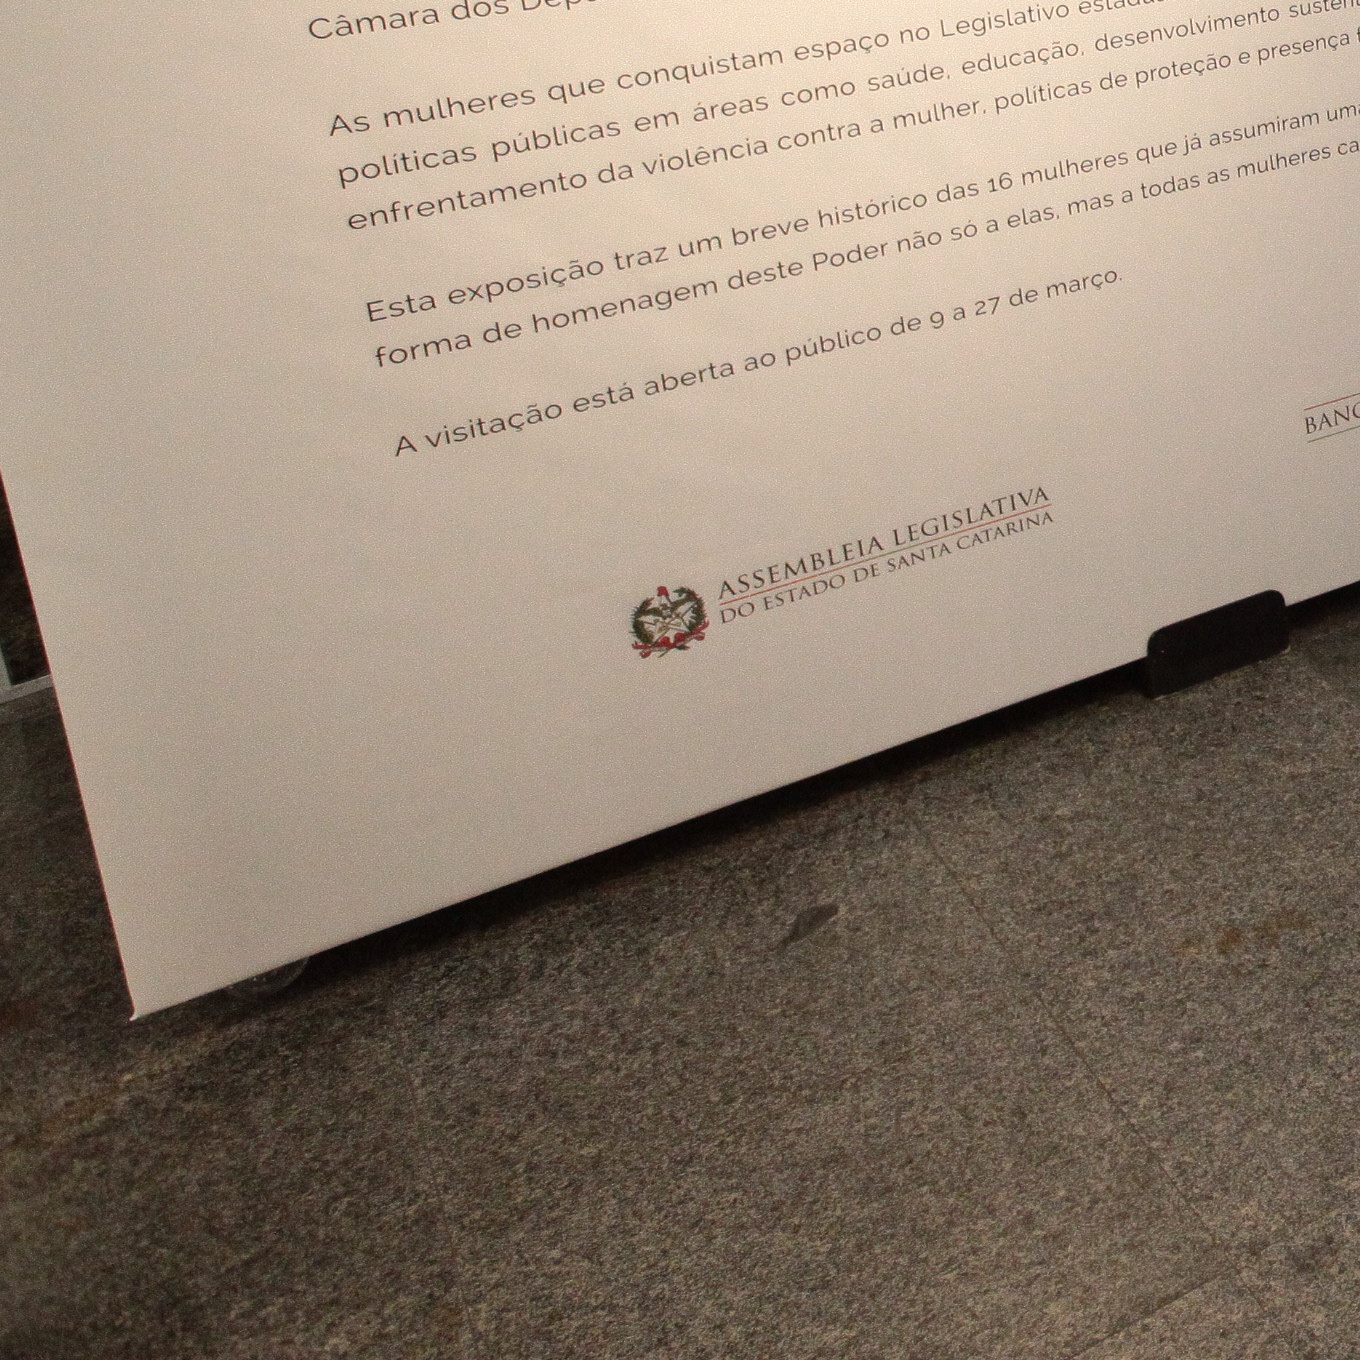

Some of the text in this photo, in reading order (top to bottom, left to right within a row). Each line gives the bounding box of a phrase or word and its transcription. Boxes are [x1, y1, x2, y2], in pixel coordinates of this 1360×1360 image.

[307, 7, 439, 39] Câmara
[337, 145, 477, 189] políticas
[491, 121, 621, 162] públicas
[633, 110, 679, 132] em
[692, 95, 768, 122] áreas
[780, 81, 855, 106] como
[867, 63, 950, 91] saúde,
[961, 41, 1084, 74] educação,
[1094, 7, 1279, 51] desenvolvimento
[365, 294, 436, 322] Esta
[447, 259, 604, 304] exposição
[613, 245, 668, 270] traz
[677, 235, 722, 257] um
[730, 217, 809, 245] breve
[817, 193, 927, 227] histórico
[935, 182, 979, 202] das
[987, 171, 1013, 192] 16
[1021, 151, 1128, 185] mulheres
[1135, 141, 1177, 164] que
[1182, 136, 1201, 156] já
[1208, 111, 1319, 146] assumiram
[394, 269, 1122, 457] A visitação está aberta ao público de 9 a 27 de março.
[718, 486, 1049, 599] ASSEMBLEIA LEGISLATIVA
[719, 511, 1054, 624] DO ESTADO DE SANTA CATARINA
